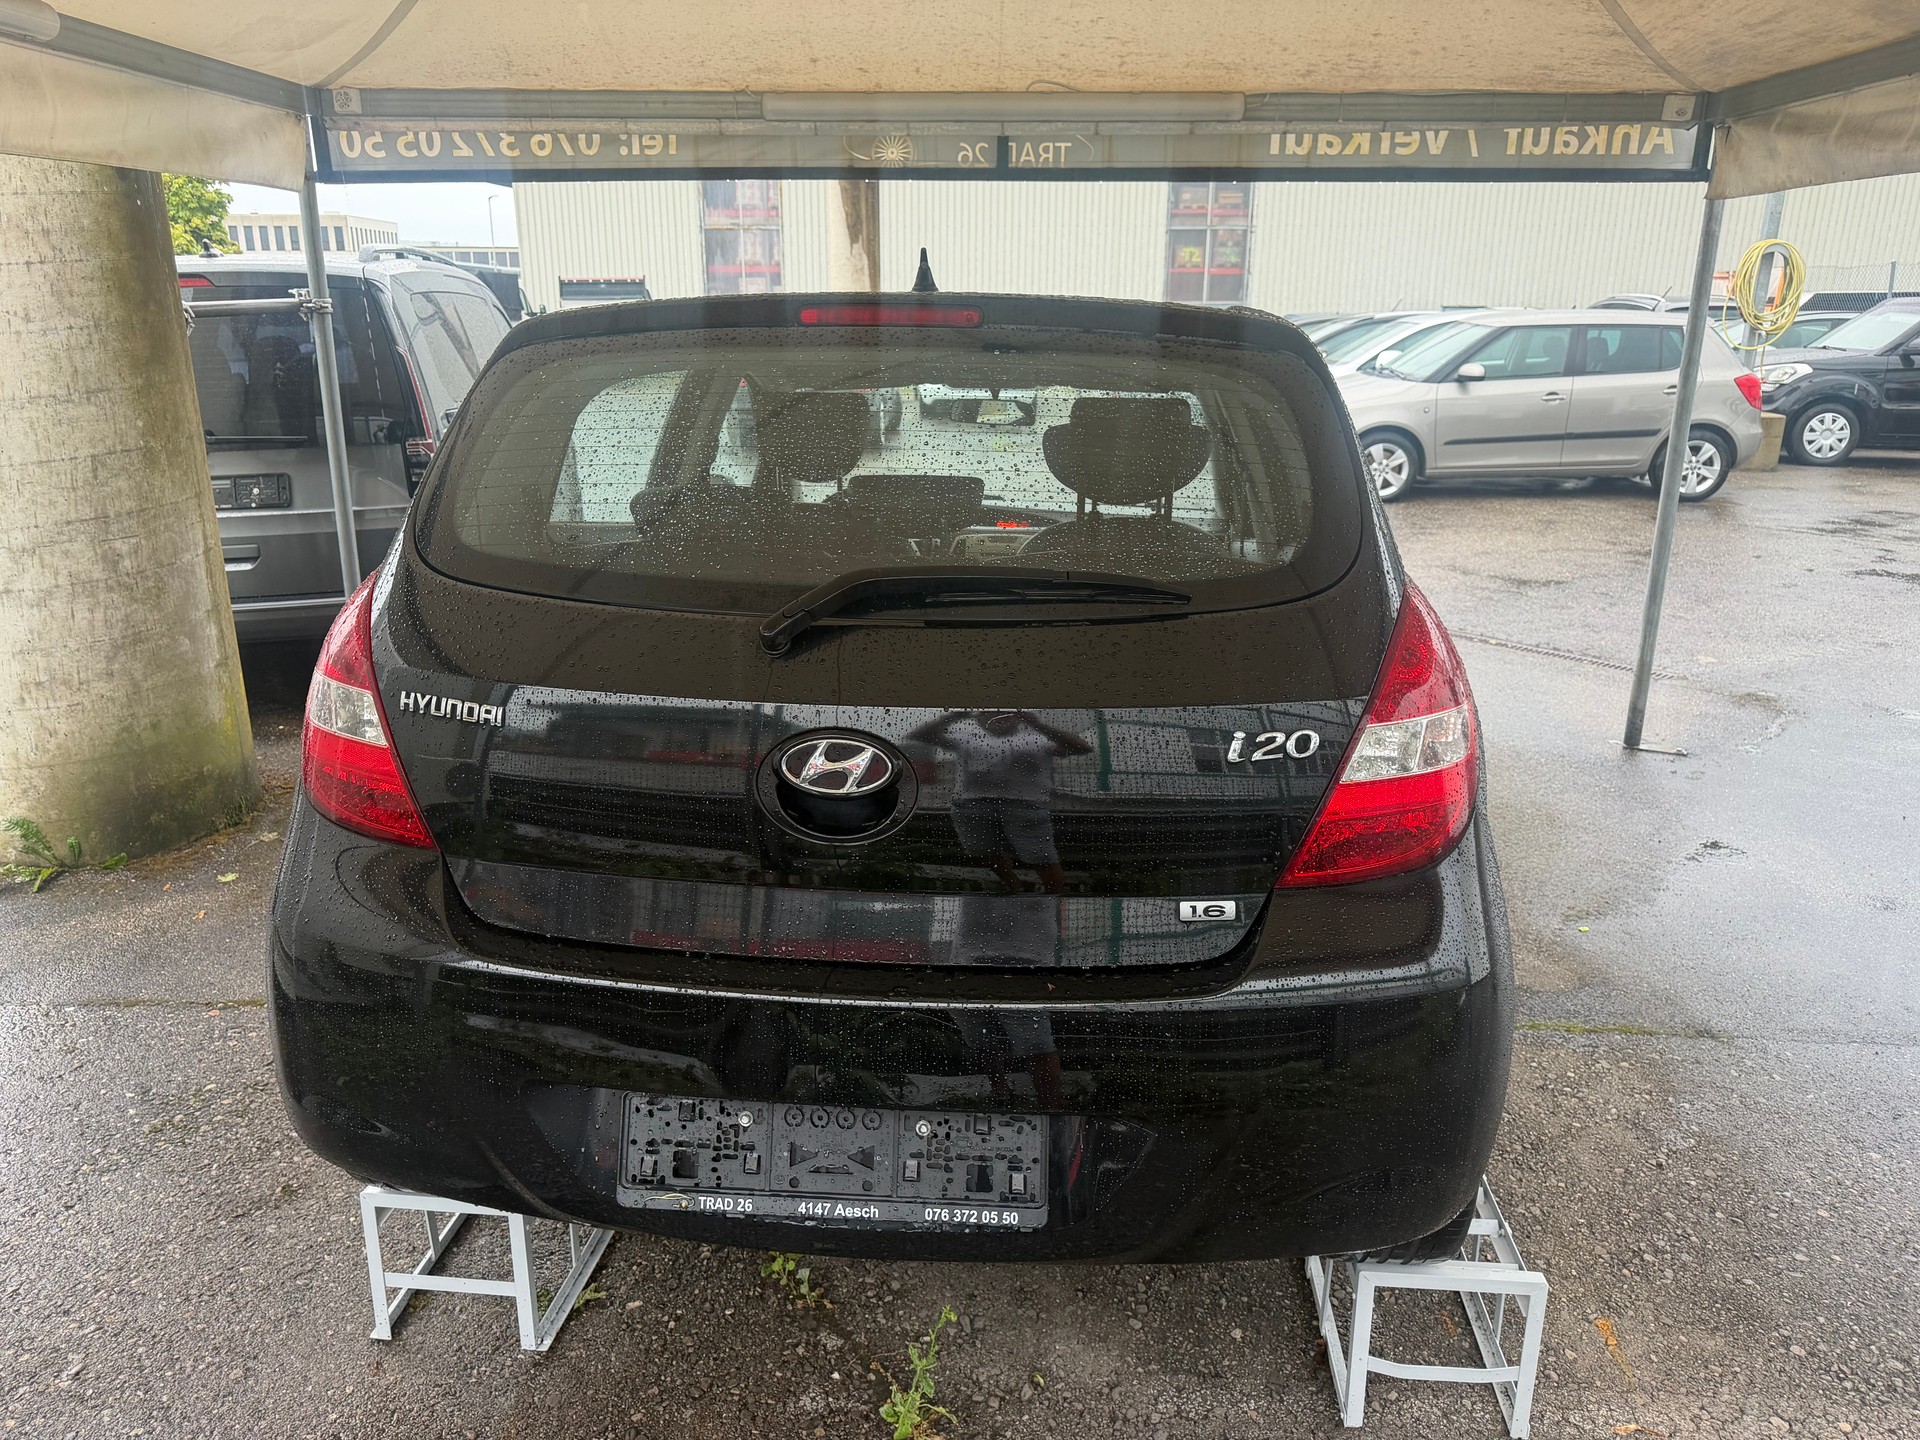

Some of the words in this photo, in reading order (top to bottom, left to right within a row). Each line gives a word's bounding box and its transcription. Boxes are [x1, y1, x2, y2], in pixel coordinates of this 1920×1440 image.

[400, 690, 504, 727] HYUNDAI
[1227, 729, 1320, 763] i20
[1189, 904, 1227, 918] 1.6
[698, 1196, 734, 1211] TRAD
[736, 1198, 753, 1212] 26
[797, 1201, 832, 1216] 4147
[833, 1203, 879, 1218] Aesch
[924, 1208, 949, 1221] 076
[953, 1209, 978, 1223] 372
[981, 1210, 999, 1224] 05
[1002, 1211, 1019, 1225] 50
